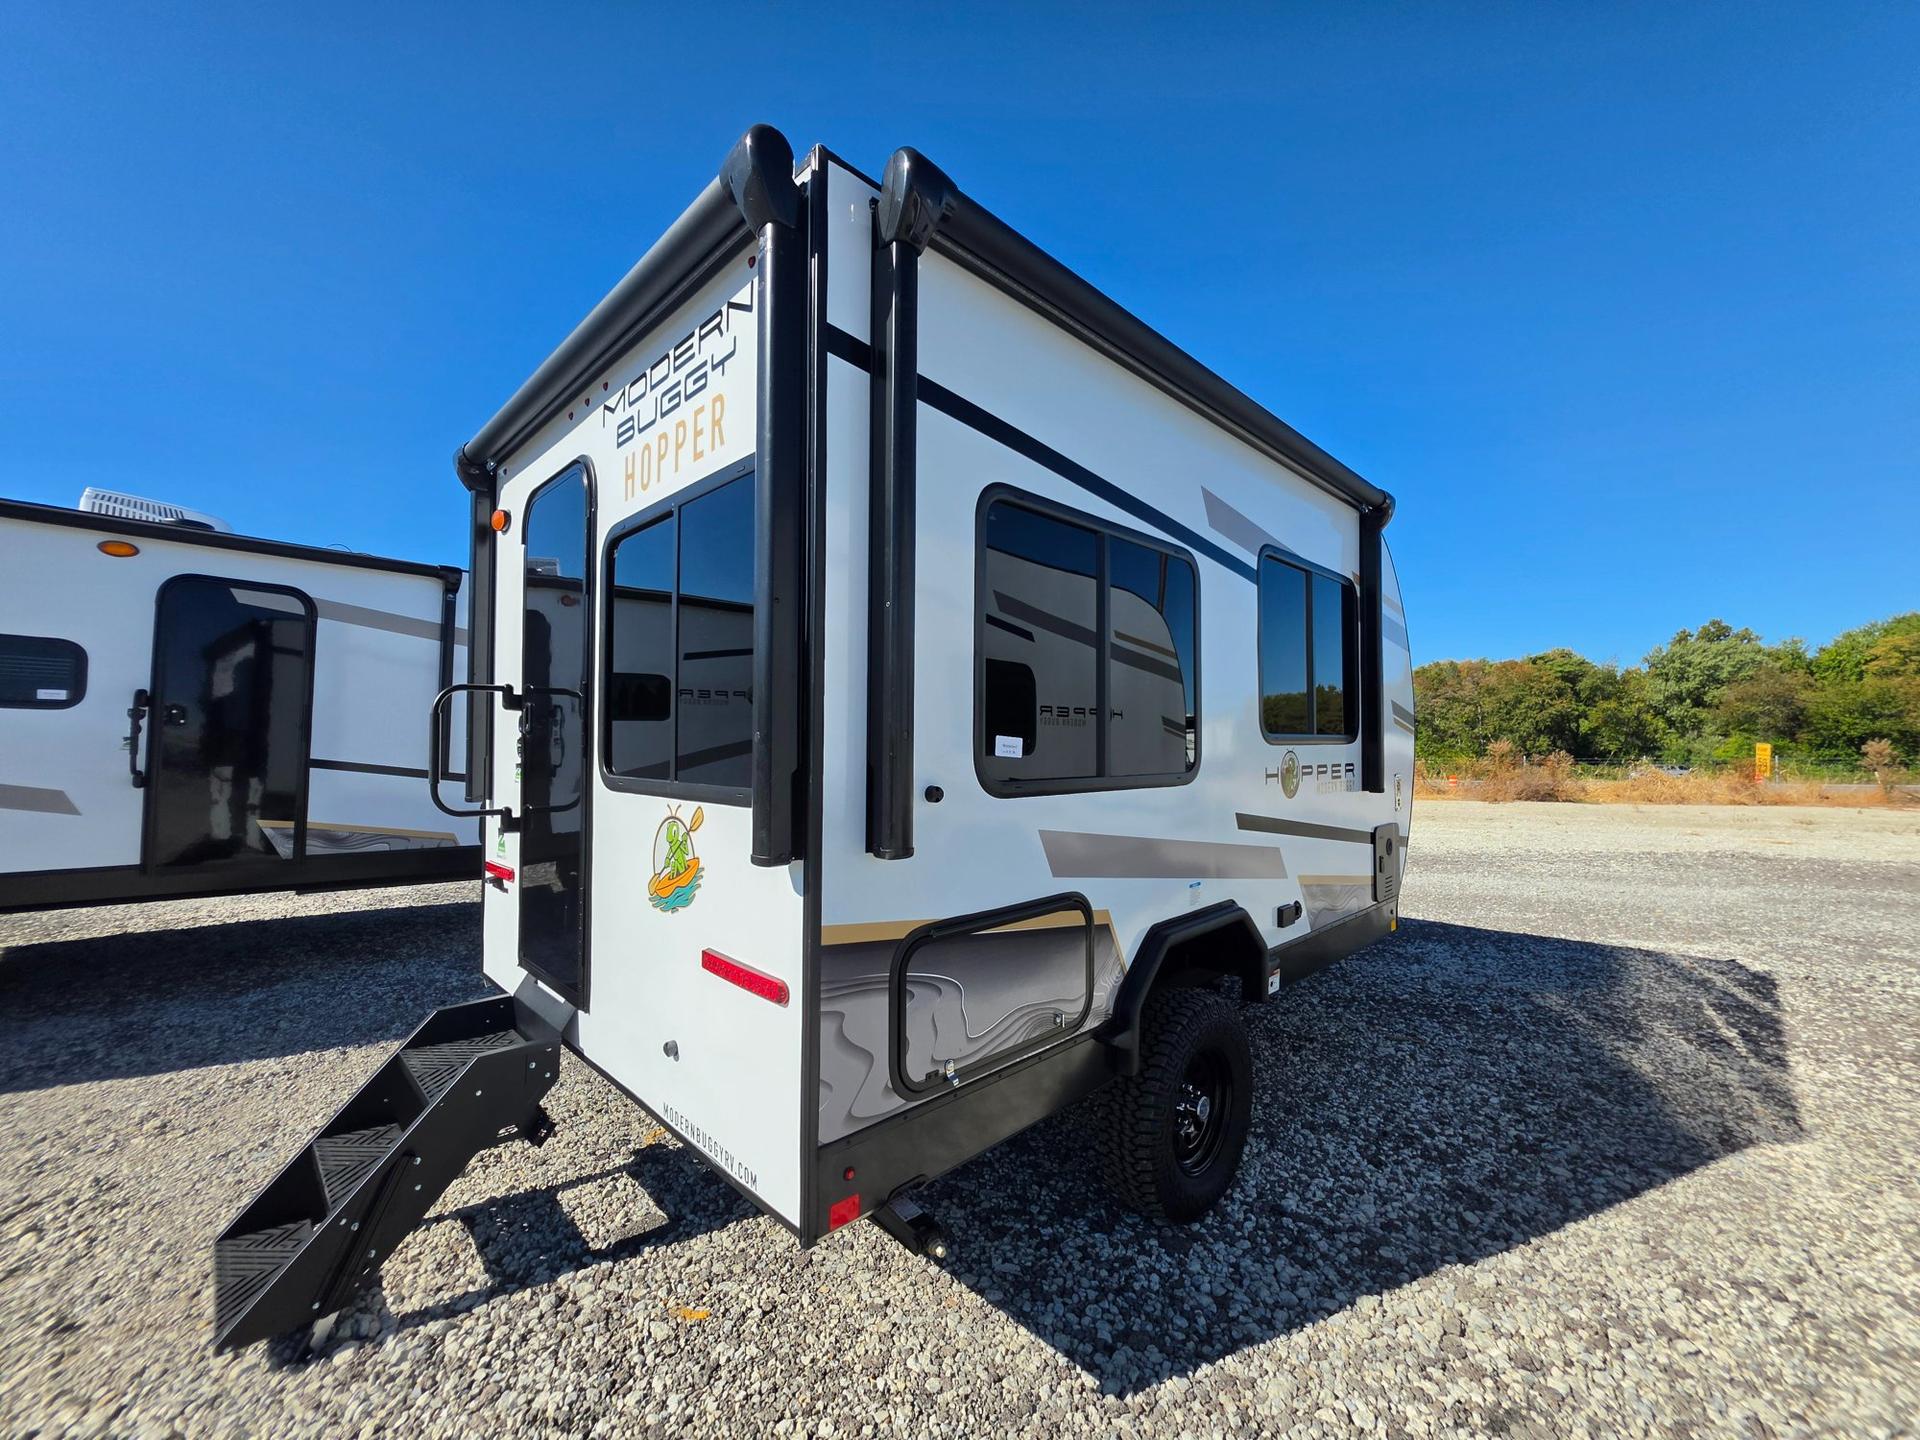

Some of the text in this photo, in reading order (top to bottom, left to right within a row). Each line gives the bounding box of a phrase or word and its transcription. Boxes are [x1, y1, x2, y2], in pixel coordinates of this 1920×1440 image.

[603, 280, 754, 429] MODERN
[616, 335, 737, 450] BUGGY
[625, 392, 725, 502] HOPPER
[663, 1102, 758, 1192] MODERNBUGGYRV.COM
